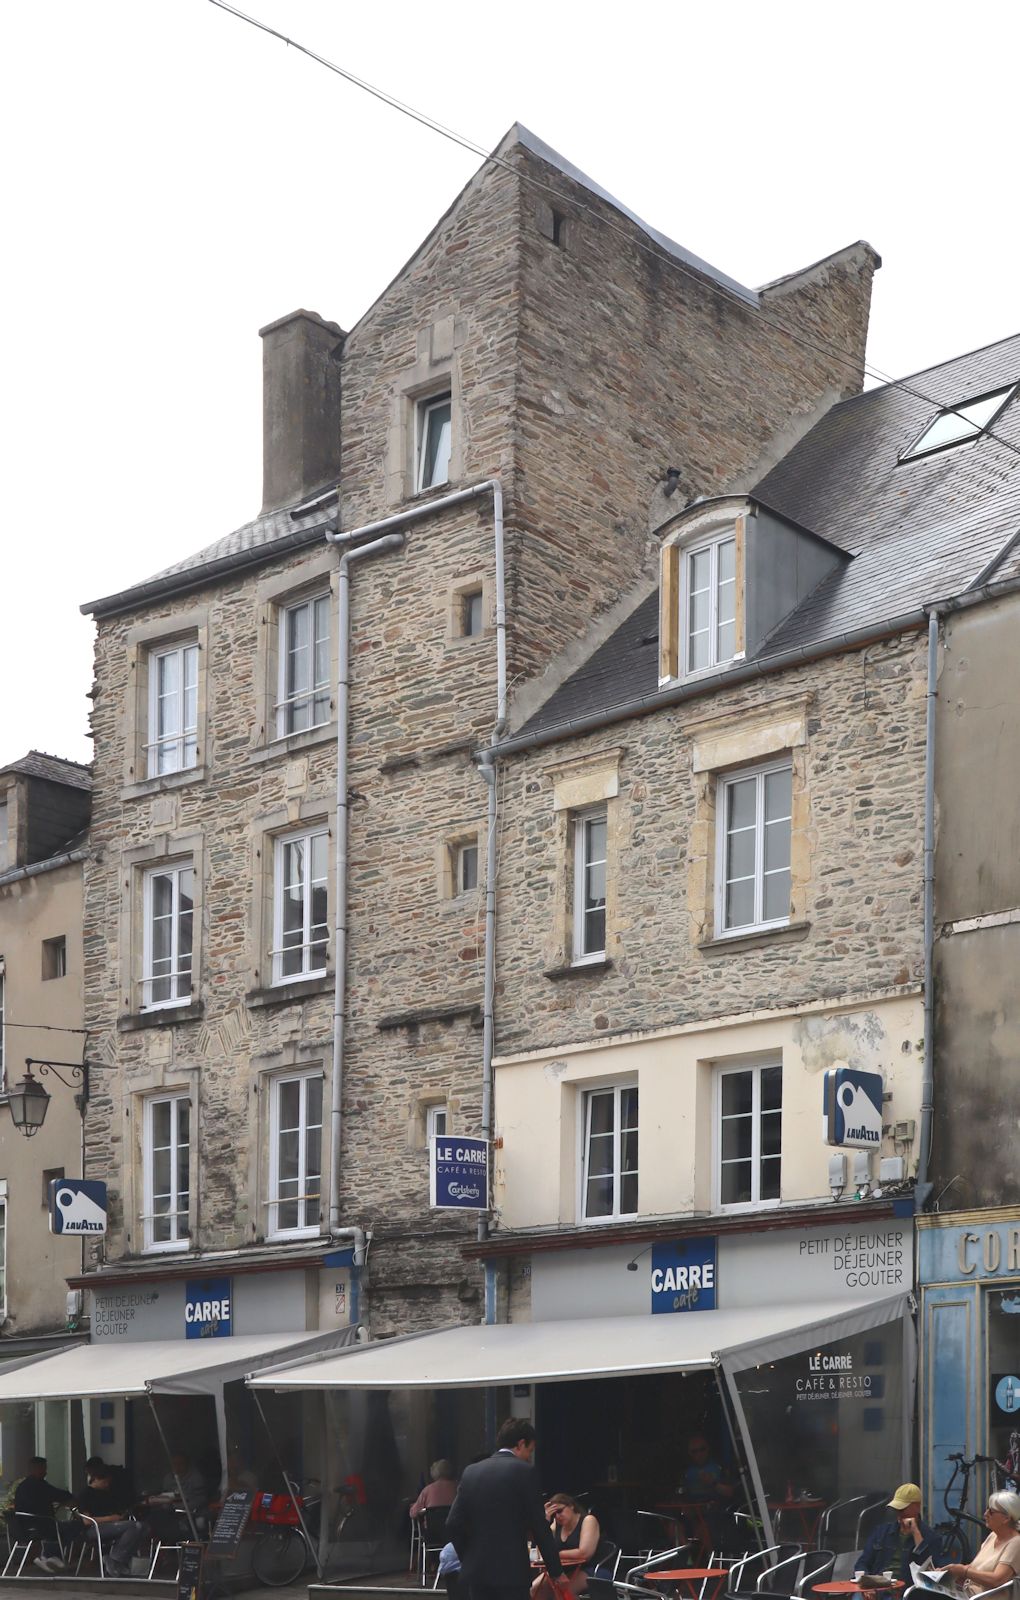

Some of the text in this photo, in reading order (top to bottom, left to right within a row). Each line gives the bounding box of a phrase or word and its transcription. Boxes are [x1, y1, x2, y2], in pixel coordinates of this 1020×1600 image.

[846, 1125, 880, 1142] LAVAZZA
[437, 1147, 487, 1164] LE CARRÉ
[437, 1165, 460, 1174] CAFÉ
[469, 1168, 487, 1177] RESTO
[447, 1182, 480, 1200] Carlsberg
[65, 1219, 104, 1231] LAVAZZA
[800, 1232, 903, 1255] PETIT DÉJEUNER
[834, 1250, 903, 1270] DÉJEUNER
[651, 1258, 714, 1293] CARRÉ
[846, 1269, 903, 1287] GOUTER
[95, 1296, 113, 1309] PETIT
[672, 1284, 699, 1310] café
[185, 1296, 230, 1323] CARRÉ
[95, 1323, 129, 1336] GOUTER
[822, 1352, 852, 1370] CARRÉ
[796, 1376, 872, 1391] CAFÉ & RESTO
